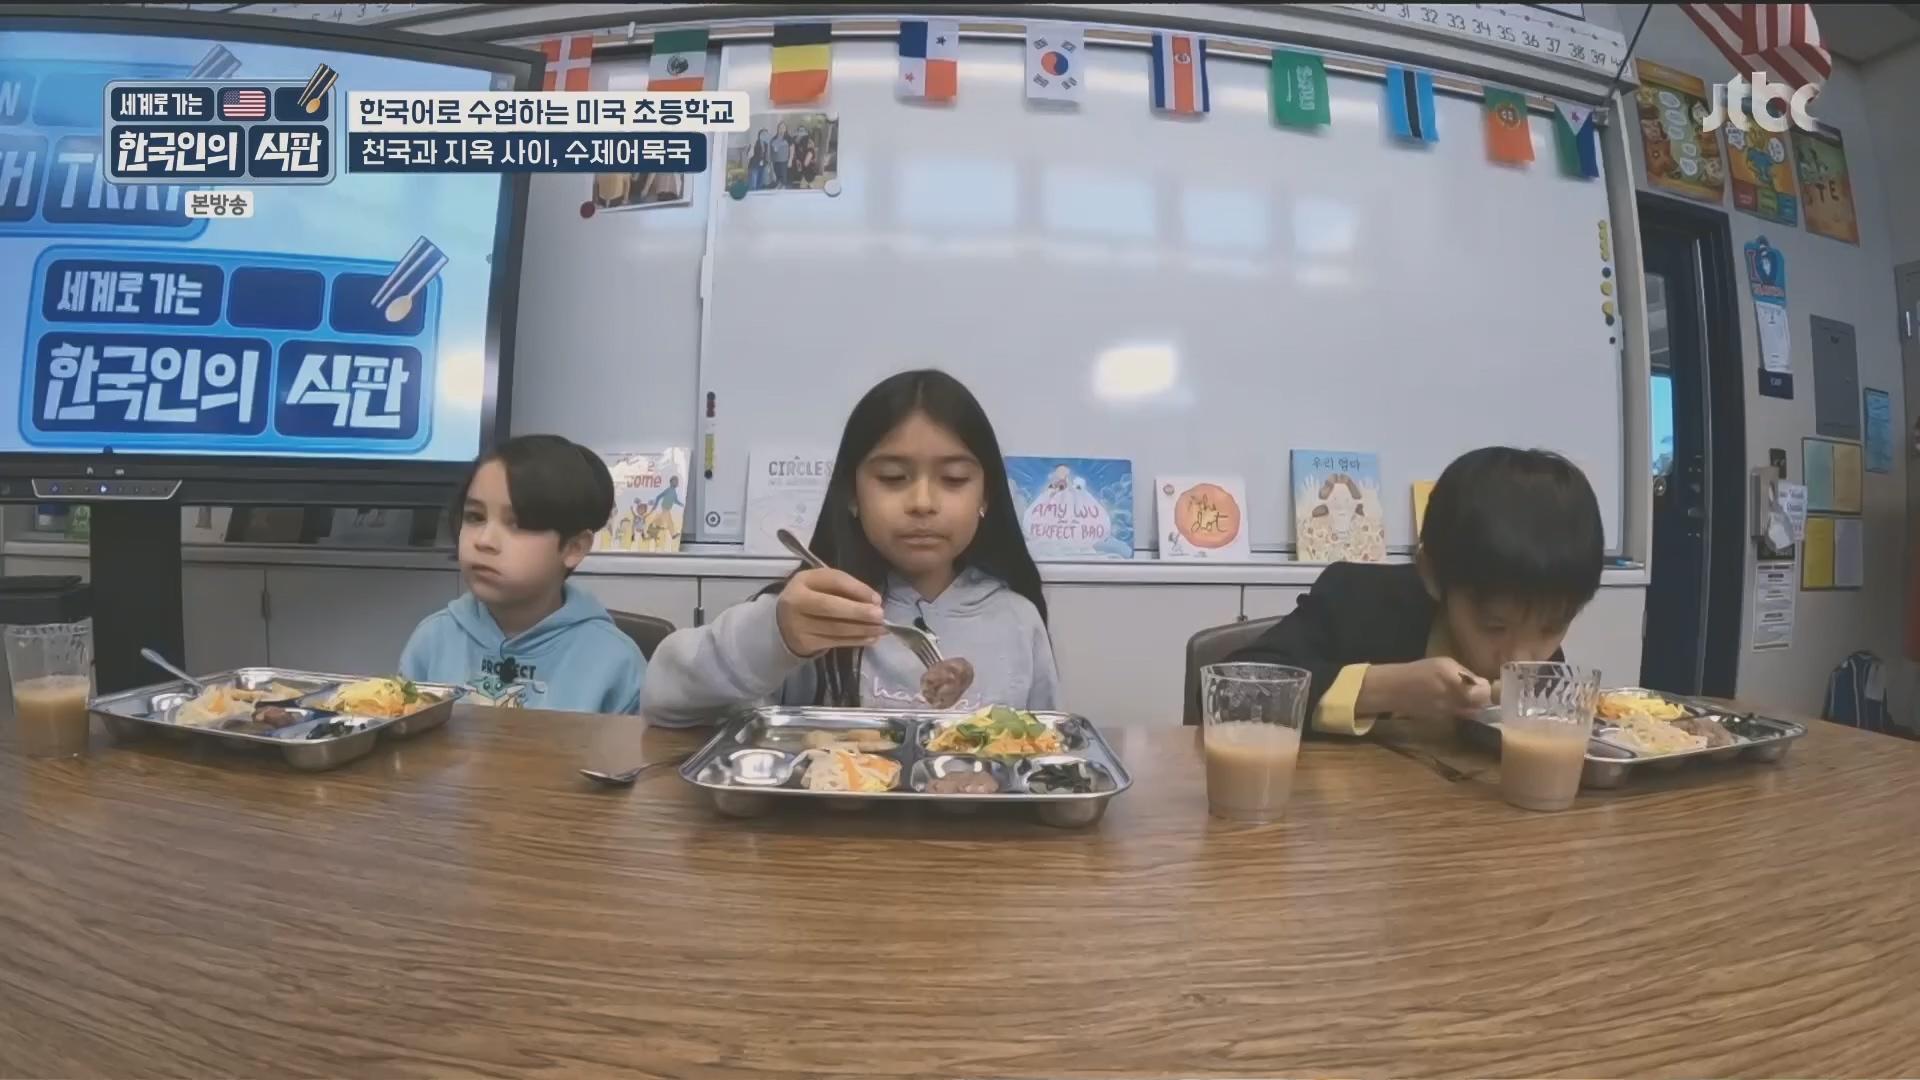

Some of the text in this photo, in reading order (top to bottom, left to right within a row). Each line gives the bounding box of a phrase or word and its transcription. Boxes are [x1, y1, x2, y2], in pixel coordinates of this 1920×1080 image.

[1420, 7, 1438, 24] 32
[1446, 13, 1466, 30] 33
[1471, 19, 1491, 36] 34
[1497, 25, 1516, 42] 35
[1521, 31, 1540, 48] 36
[1545, 37, 1561, 54] 37
[1568, 43, 1585, 60] 38
[1590, 49, 1606, 66] 39
[57, 269, 203, 316] 세계로 가는
[43, 341, 409, 429] 한국인의 식판
[1311, 456, 1334, 471] 우리
[1031, 503, 1100, 519] AMY WU
[481, 657, 537, 680] PROECT
